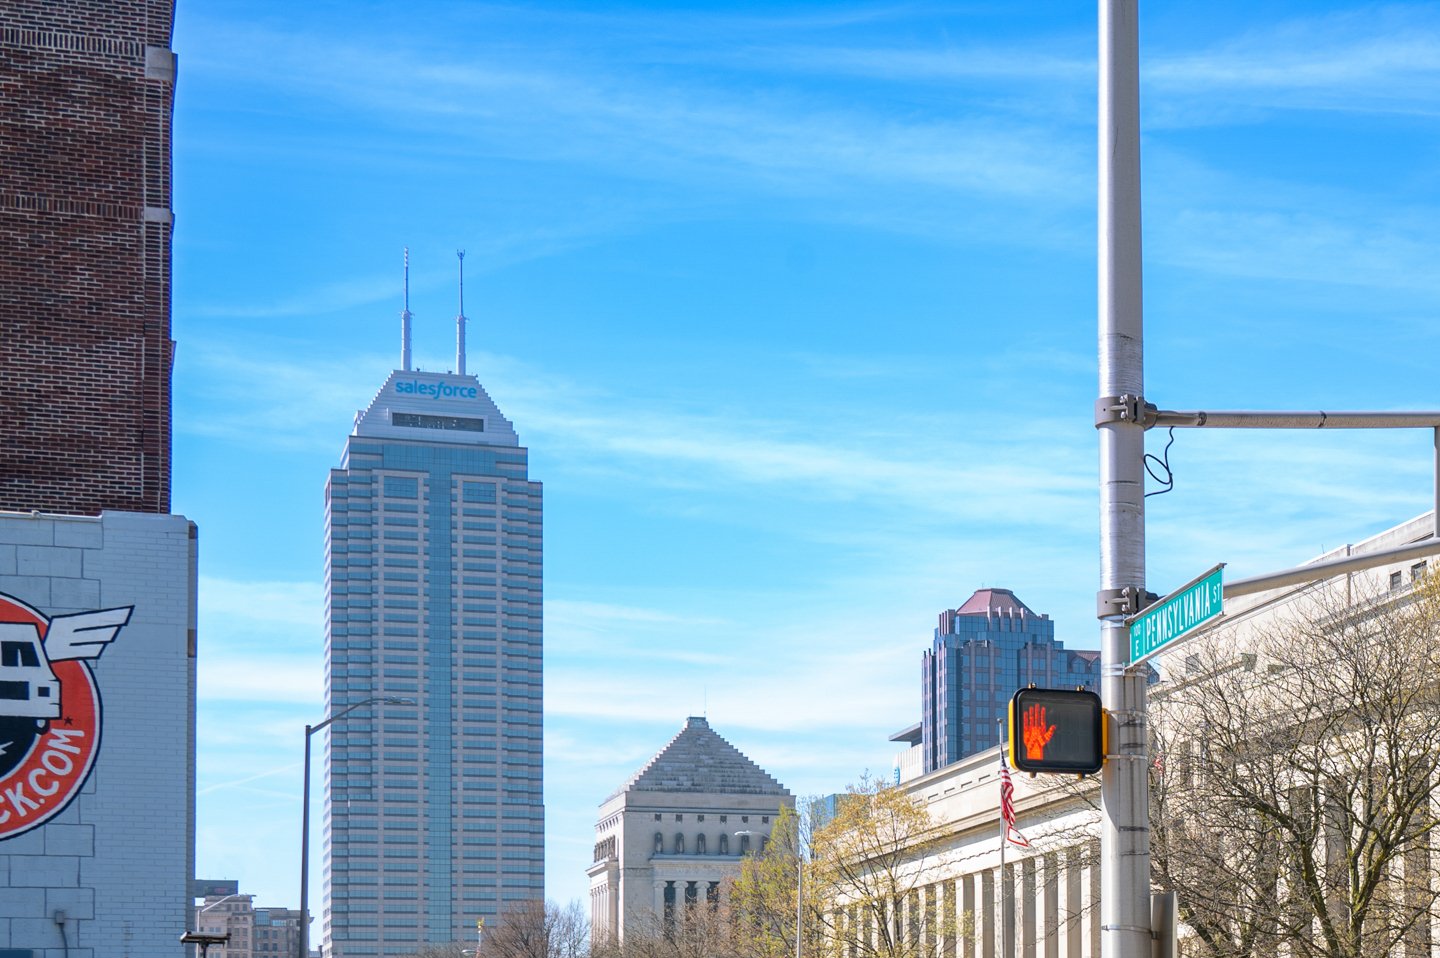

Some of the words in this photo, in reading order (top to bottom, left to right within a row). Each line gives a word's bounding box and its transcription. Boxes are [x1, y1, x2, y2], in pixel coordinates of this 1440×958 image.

[395, 380, 477, 399] salesforce
[1146, 582, 1211, 650] PENNSYLVANIA
[1213, 583, 1221, 604] ST
[1135, 640, 1140, 657] E
